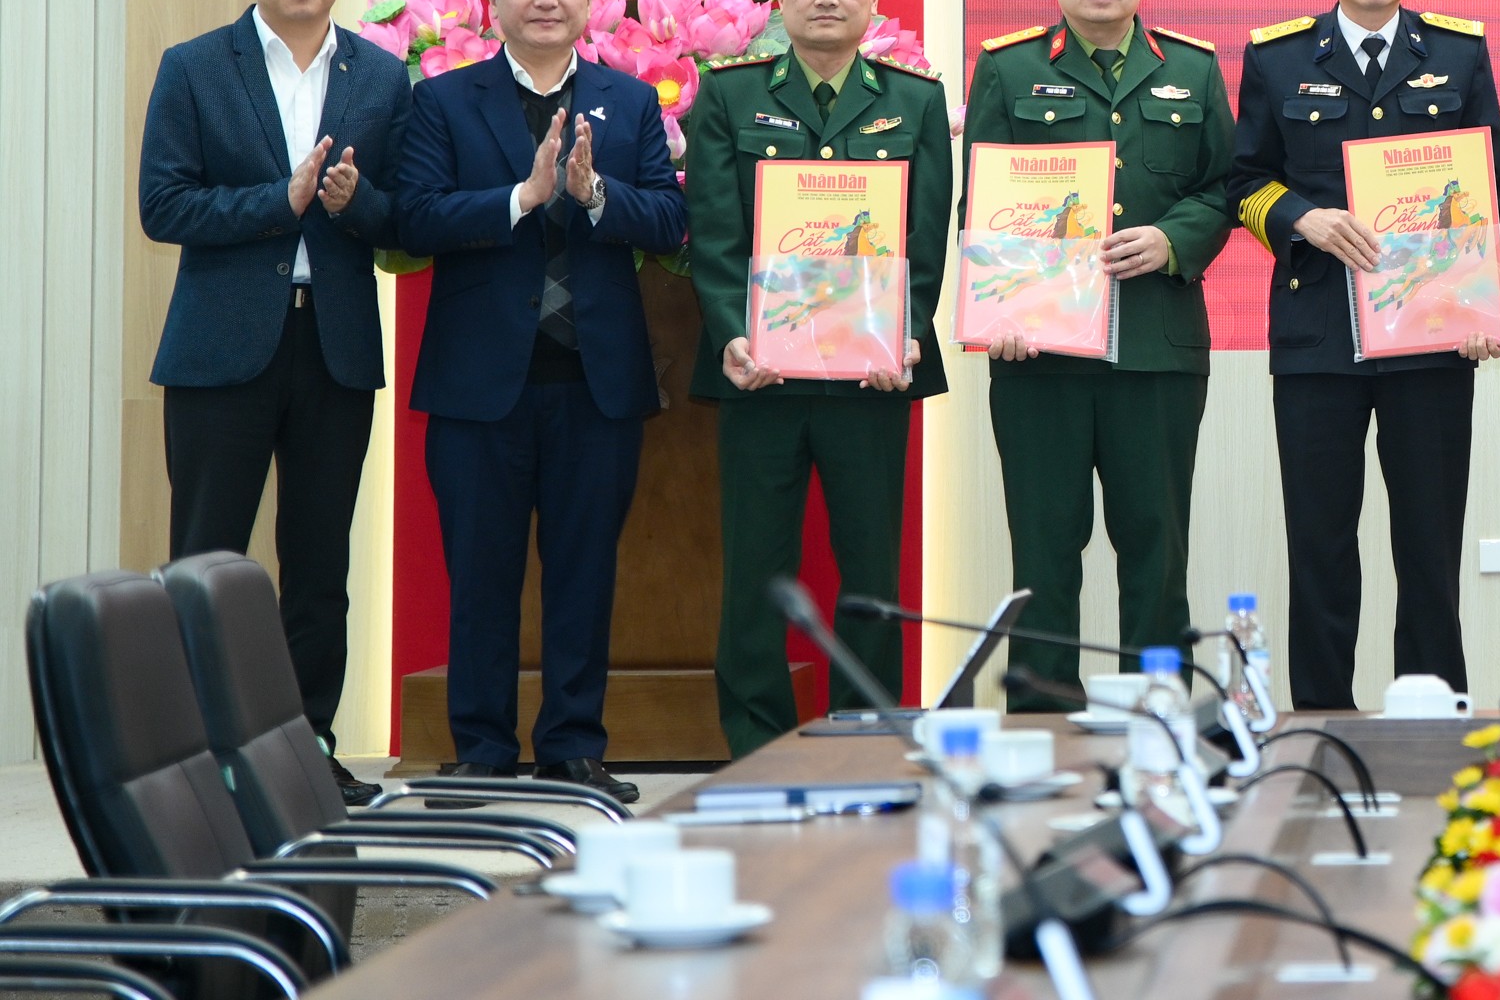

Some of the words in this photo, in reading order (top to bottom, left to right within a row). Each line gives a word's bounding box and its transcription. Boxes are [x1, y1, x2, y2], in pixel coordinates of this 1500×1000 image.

[1383, 147, 1422, 165] Nhân
[1424, 145, 1452, 161] Dân
[1009, 157, 1048, 172] Nhân
[1050, 157, 1077, 171] Dân
[797, 173, 838, 189] Nhân
[838, 174, 867, 189] Dân
[1016, 202, 1050, 210] XUÂN
[1396, 195, 1431, 205] XUÂN
[804, 220, 841, 229] XUÂN
[988, 208, 1036, 231] Cất
[1374, 205, 1418, 233] Cất
[778, 228, 826, 254] Cất
